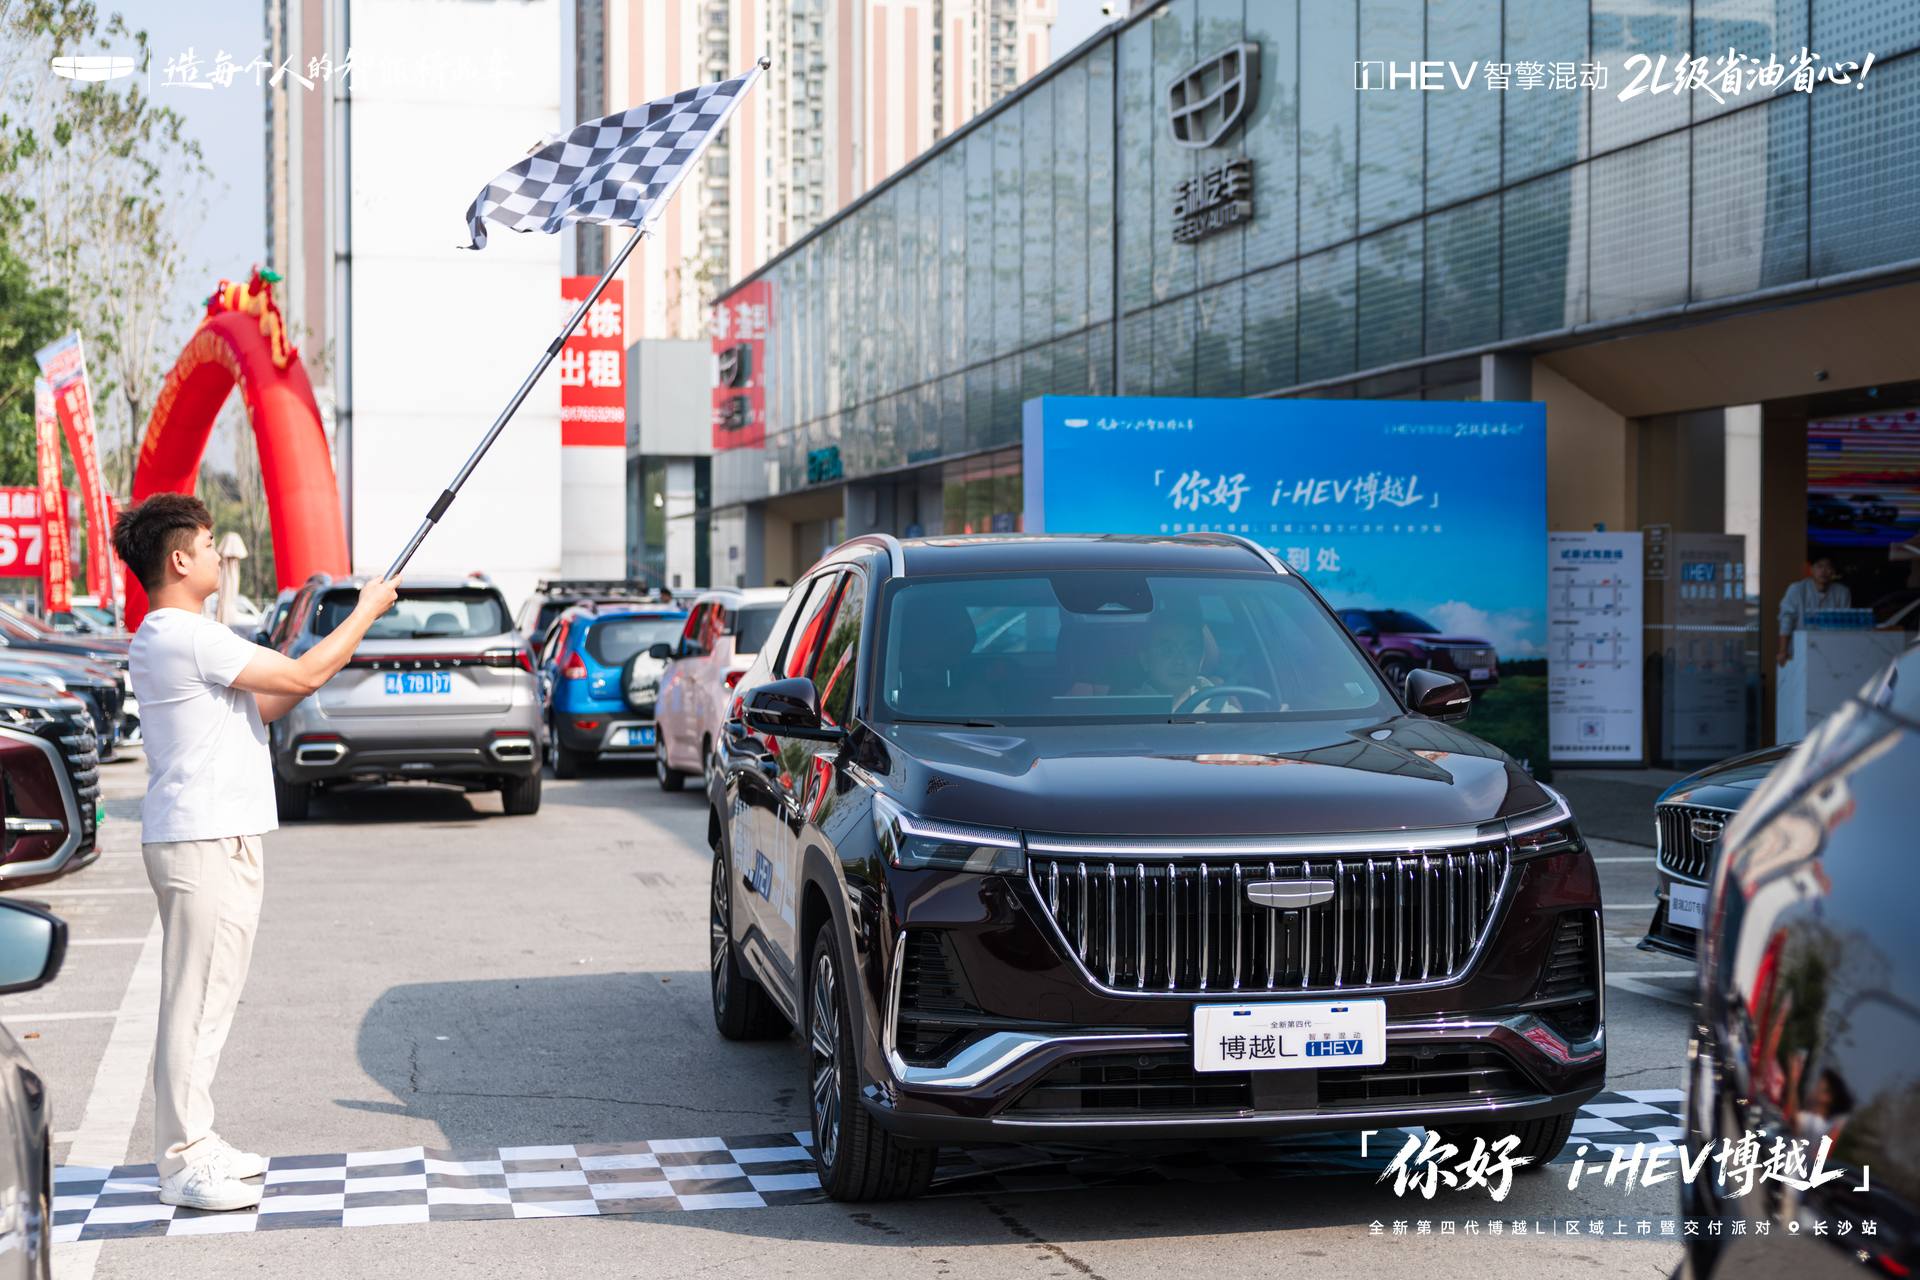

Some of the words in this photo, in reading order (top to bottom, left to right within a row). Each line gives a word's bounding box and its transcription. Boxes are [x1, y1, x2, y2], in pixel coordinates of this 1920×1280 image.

[561, 347, 622, 388] 出租
[1266, 546, 1341, 572] 到处
[1270, 1020, 1312, 1029] 全新第四代
[1219, 1034, 1298, 1061] 博越L
